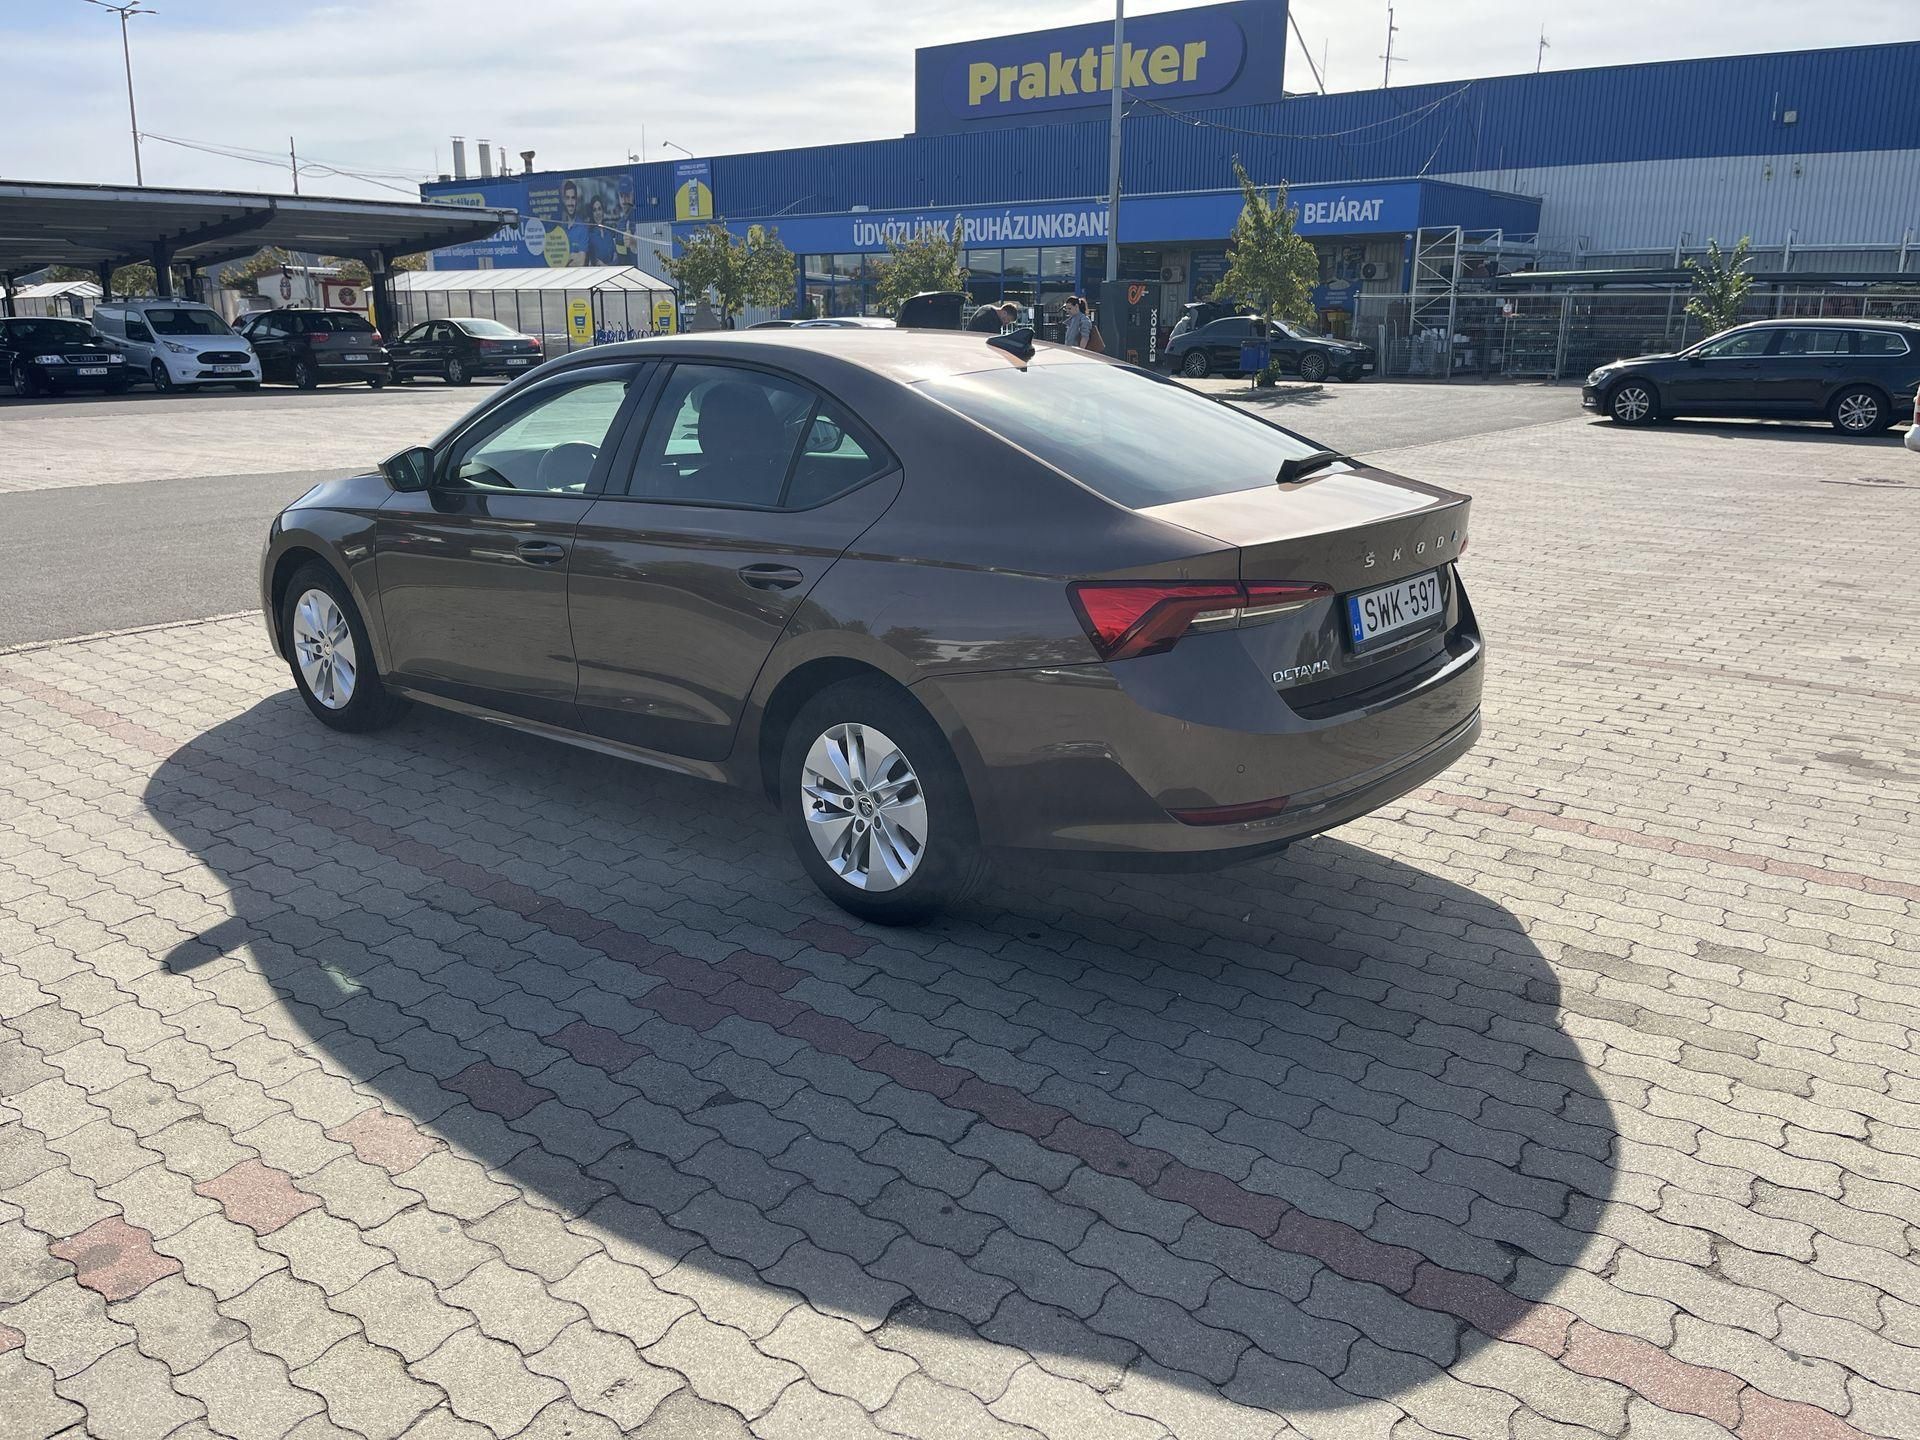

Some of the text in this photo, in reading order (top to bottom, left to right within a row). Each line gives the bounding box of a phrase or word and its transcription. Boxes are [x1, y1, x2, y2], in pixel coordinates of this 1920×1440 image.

[968, 41, 1207, 106] Praktiker
[1304, 195, 1384, 224] BEJÁRAT
[853, 216, 951, 247] ÜDVÖZLÜNK
[1149, 308, 1158, 363] EXOBOX
[1364, 529, 1459, 568] ŠKODA
[1353, 577, 1436, 636] H SWK-597
[1272, 660, 1330, 684] OCTAVIA
